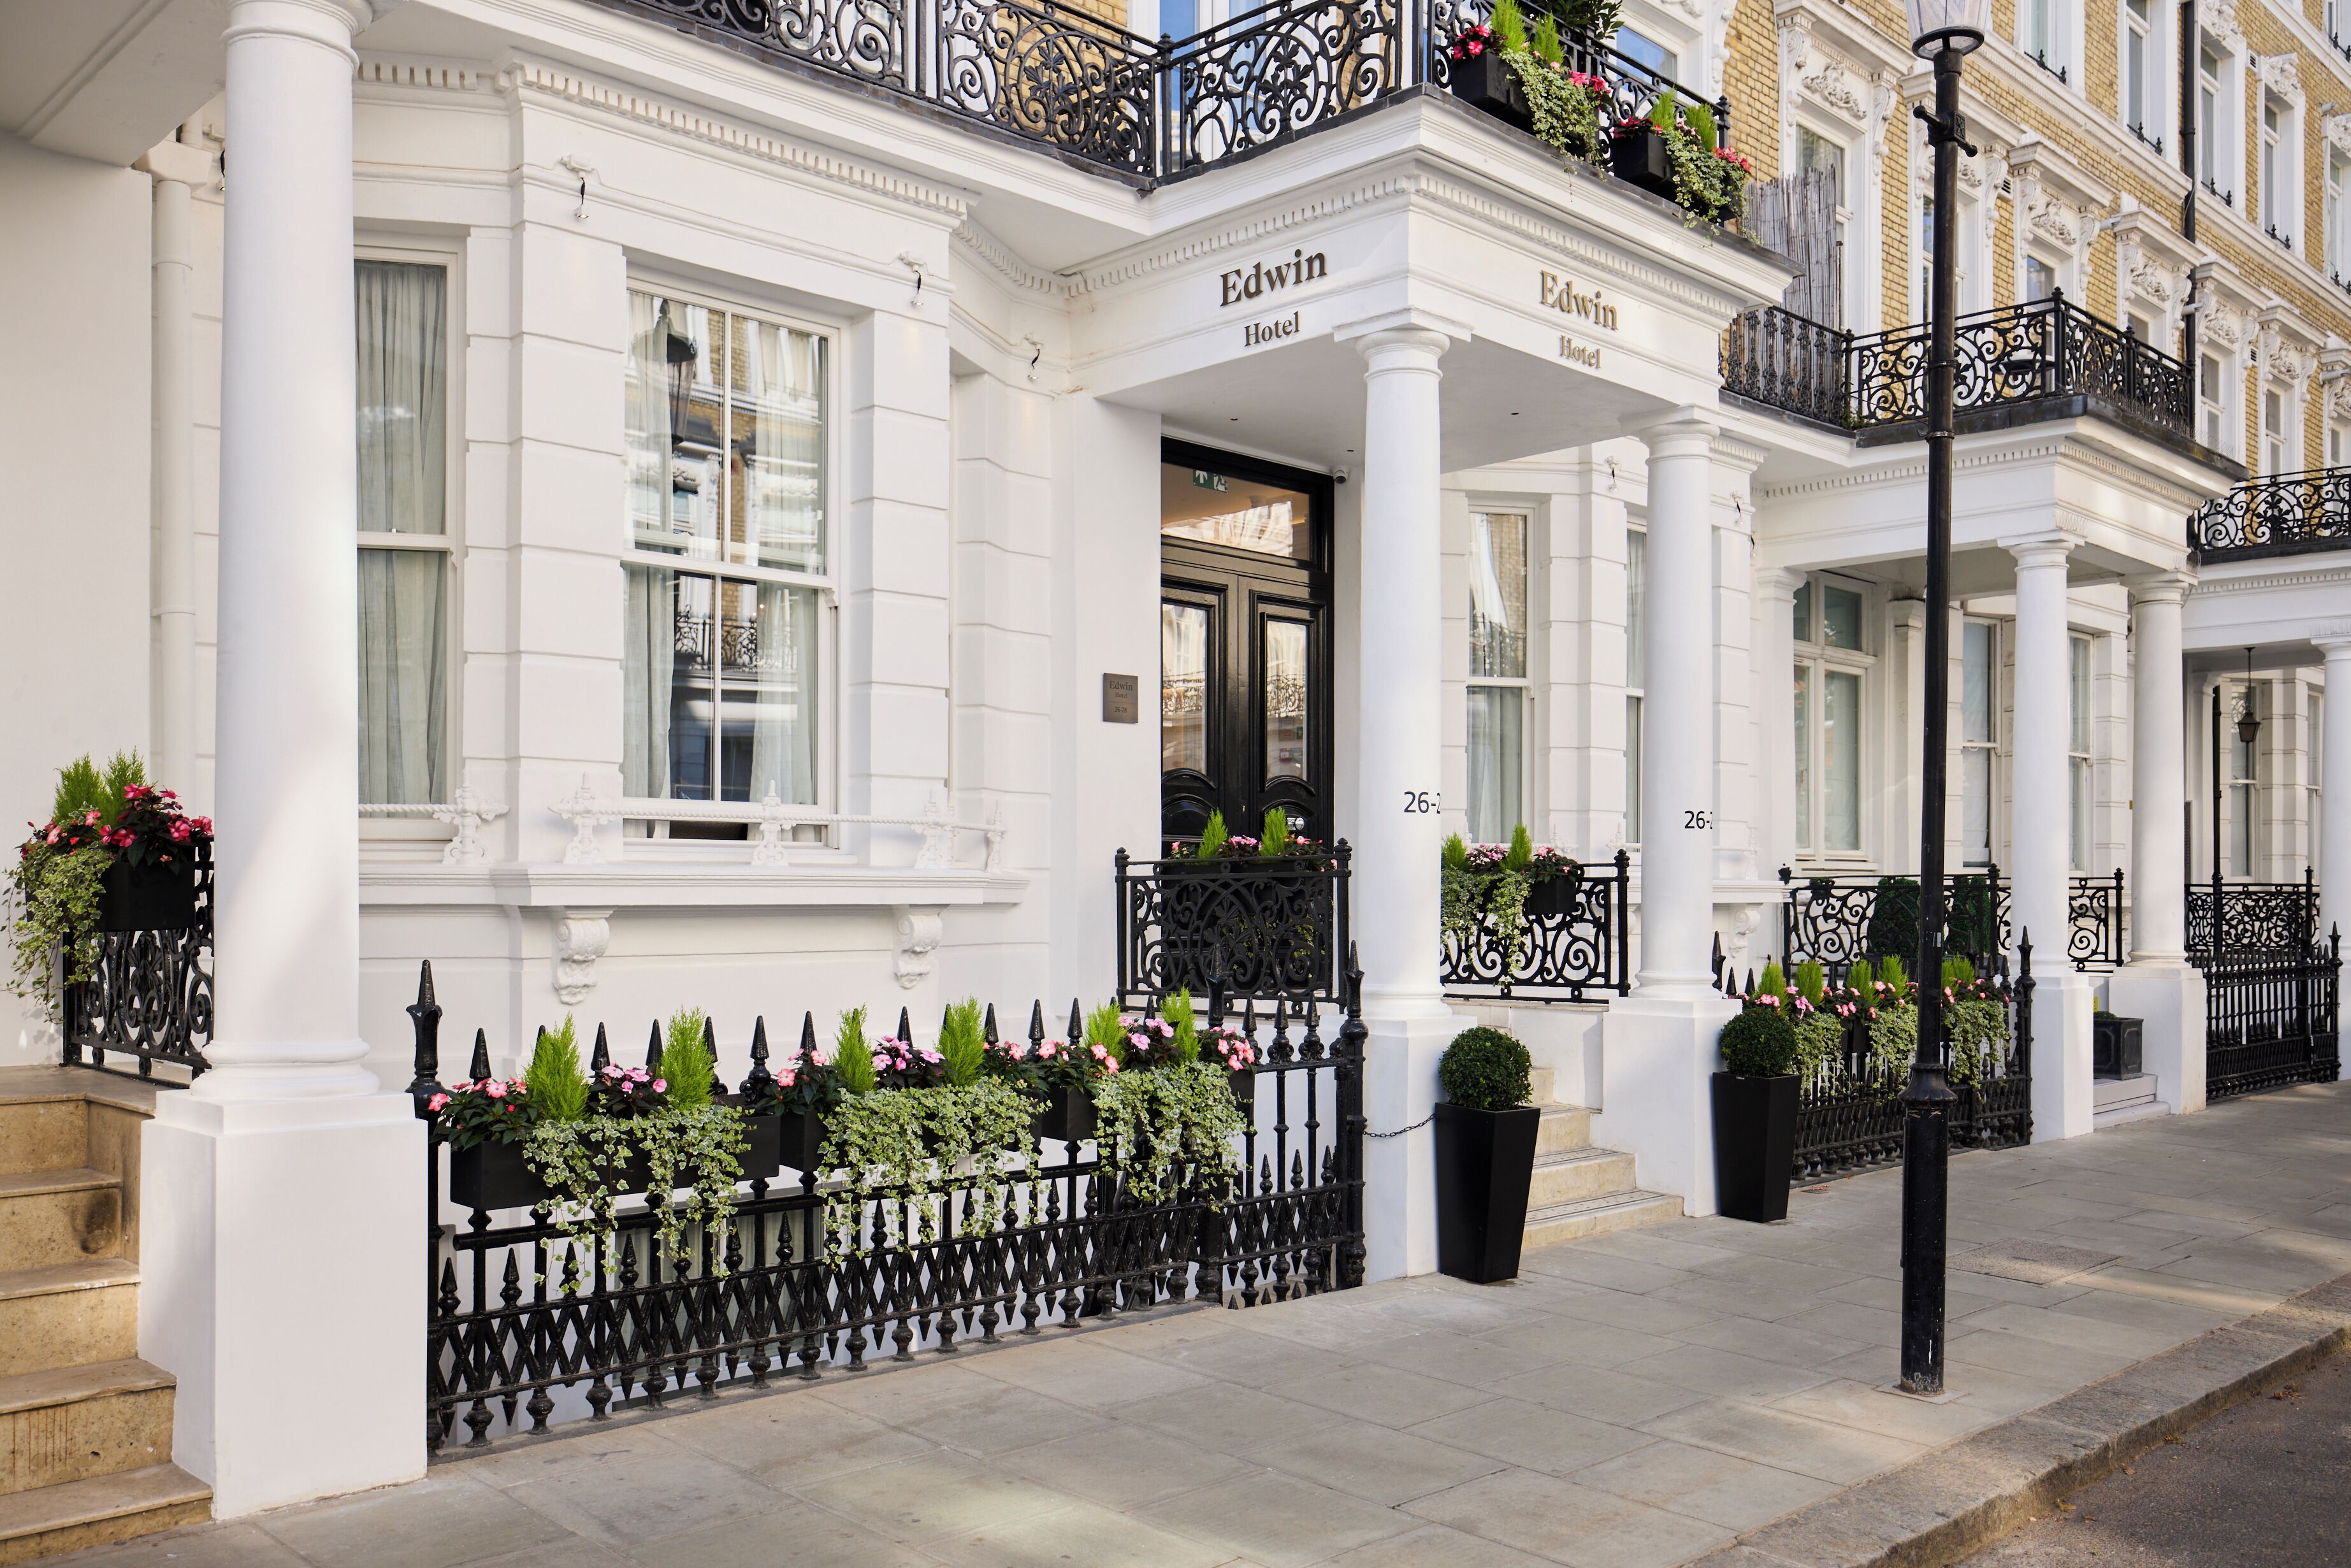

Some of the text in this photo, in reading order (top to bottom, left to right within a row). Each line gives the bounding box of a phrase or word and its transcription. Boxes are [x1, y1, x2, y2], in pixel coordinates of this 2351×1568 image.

[1220, 248, 1327, 307] Edwin
[1540, 270, 1619, 331] Edwin
[1244, 311, 1300, 347] Hotel
[1560, 334, 1602, 369] Hotel
[1109, 680, 1133, 691] Edwin
